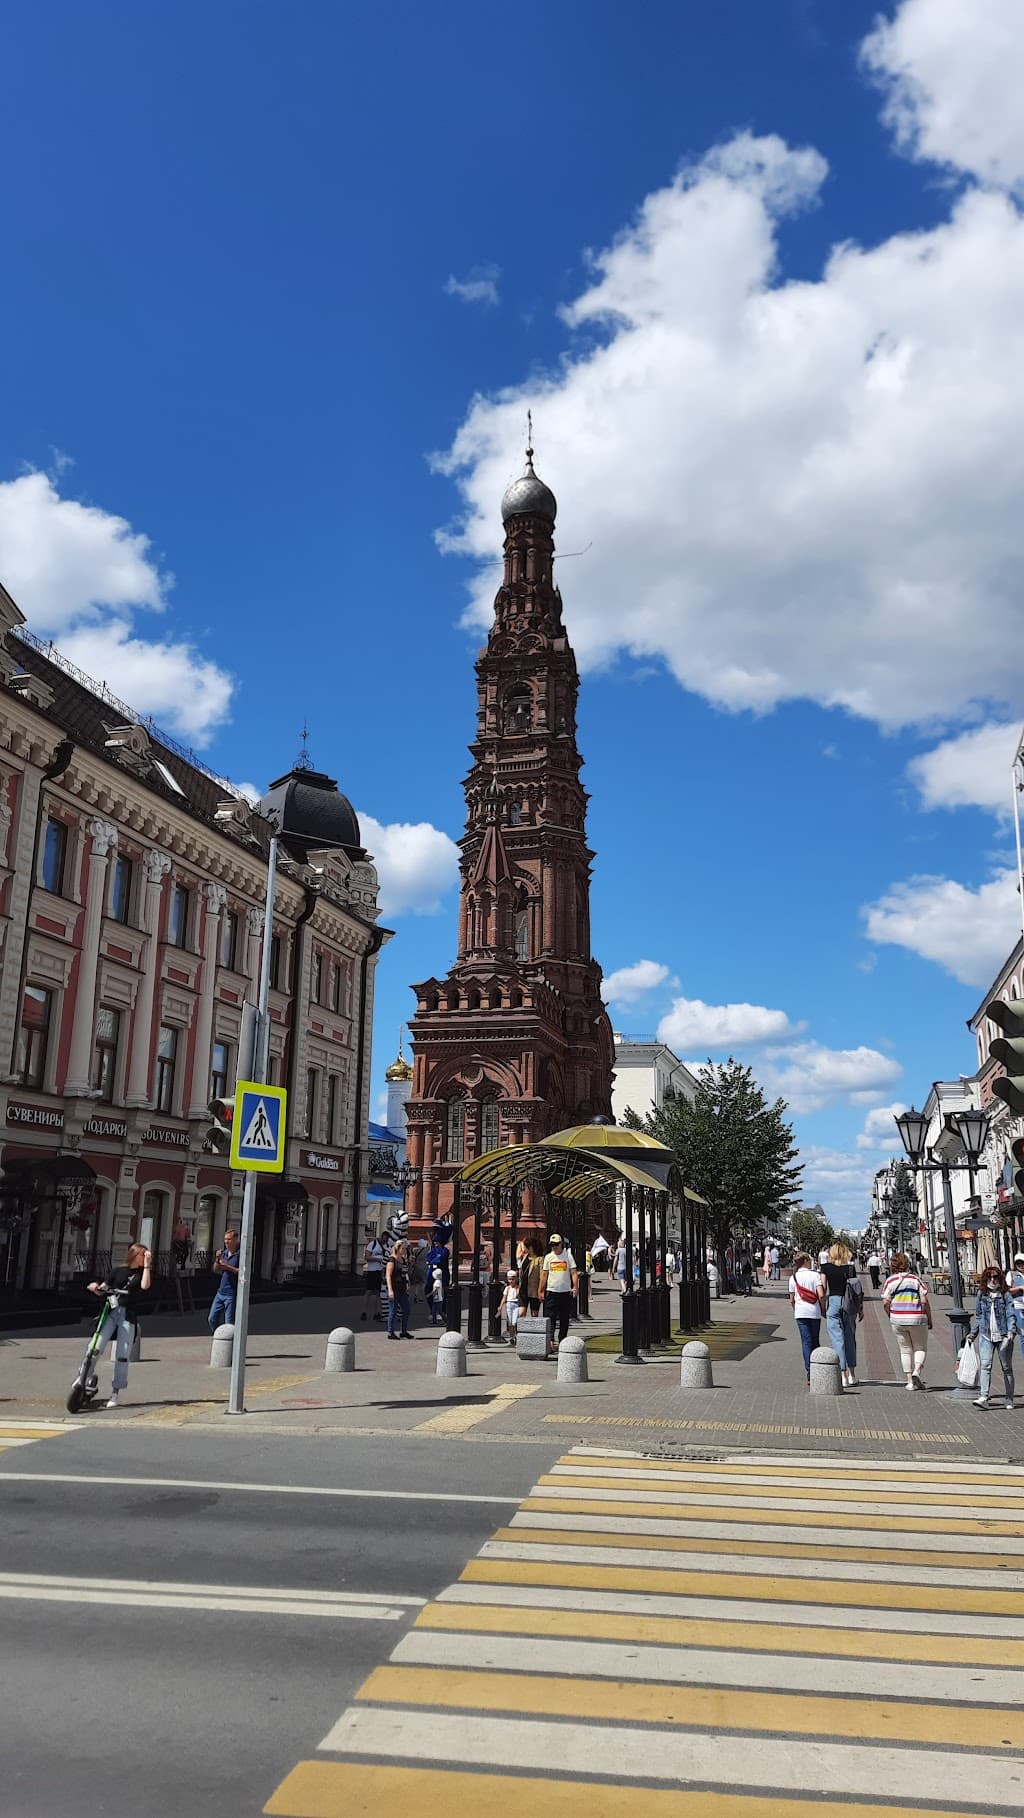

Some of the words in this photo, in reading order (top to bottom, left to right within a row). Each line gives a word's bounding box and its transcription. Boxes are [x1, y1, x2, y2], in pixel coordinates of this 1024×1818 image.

[7, 1106, 64, 1127] СУВЕНИРЫ
[84, 1119, 127, 1136] ПОДАРКИ
[141, 1128, 190, 1145] SOUVENIRS
